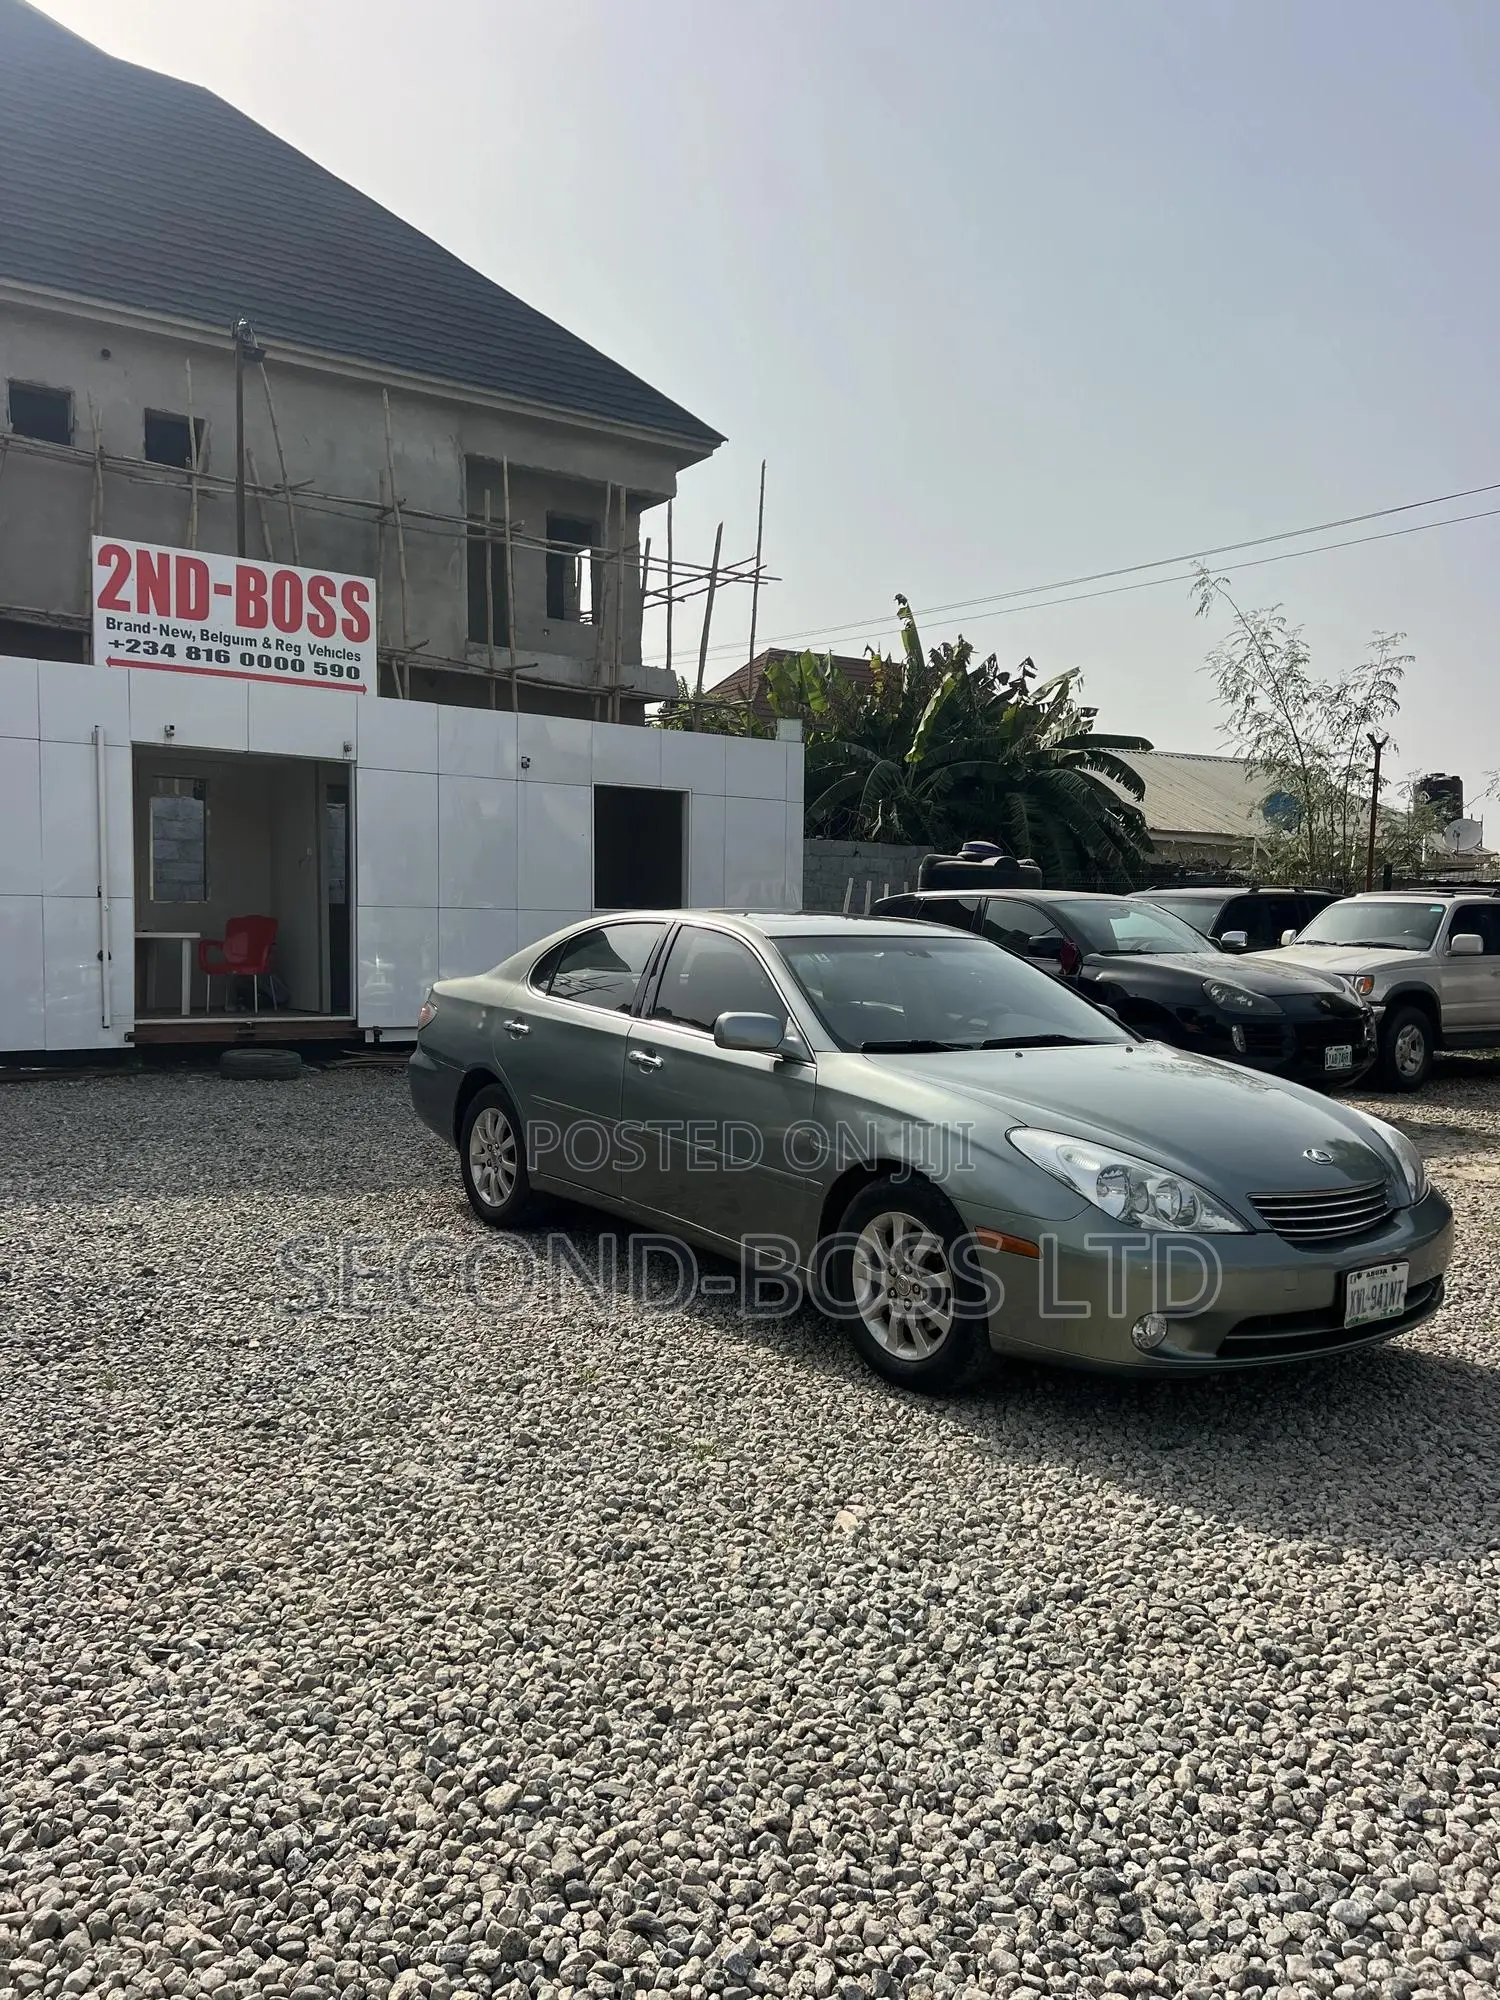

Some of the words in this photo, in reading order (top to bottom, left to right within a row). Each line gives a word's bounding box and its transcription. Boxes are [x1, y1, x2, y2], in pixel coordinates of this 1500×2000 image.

[97, 543, 371, 643] 2ND-BOSS
[105, 616, 196, 642] Brand-New,
[262, 636, 272, 650] &
[275, 638, 302, 657] Reg
[308, 643, 362, 662] Vehicles
[108, 638, 177, 658] +234
[185, 645, 230, 664] 816
[239, 652, 305, 673] 0000
[313, 661, 361, 680] 590
